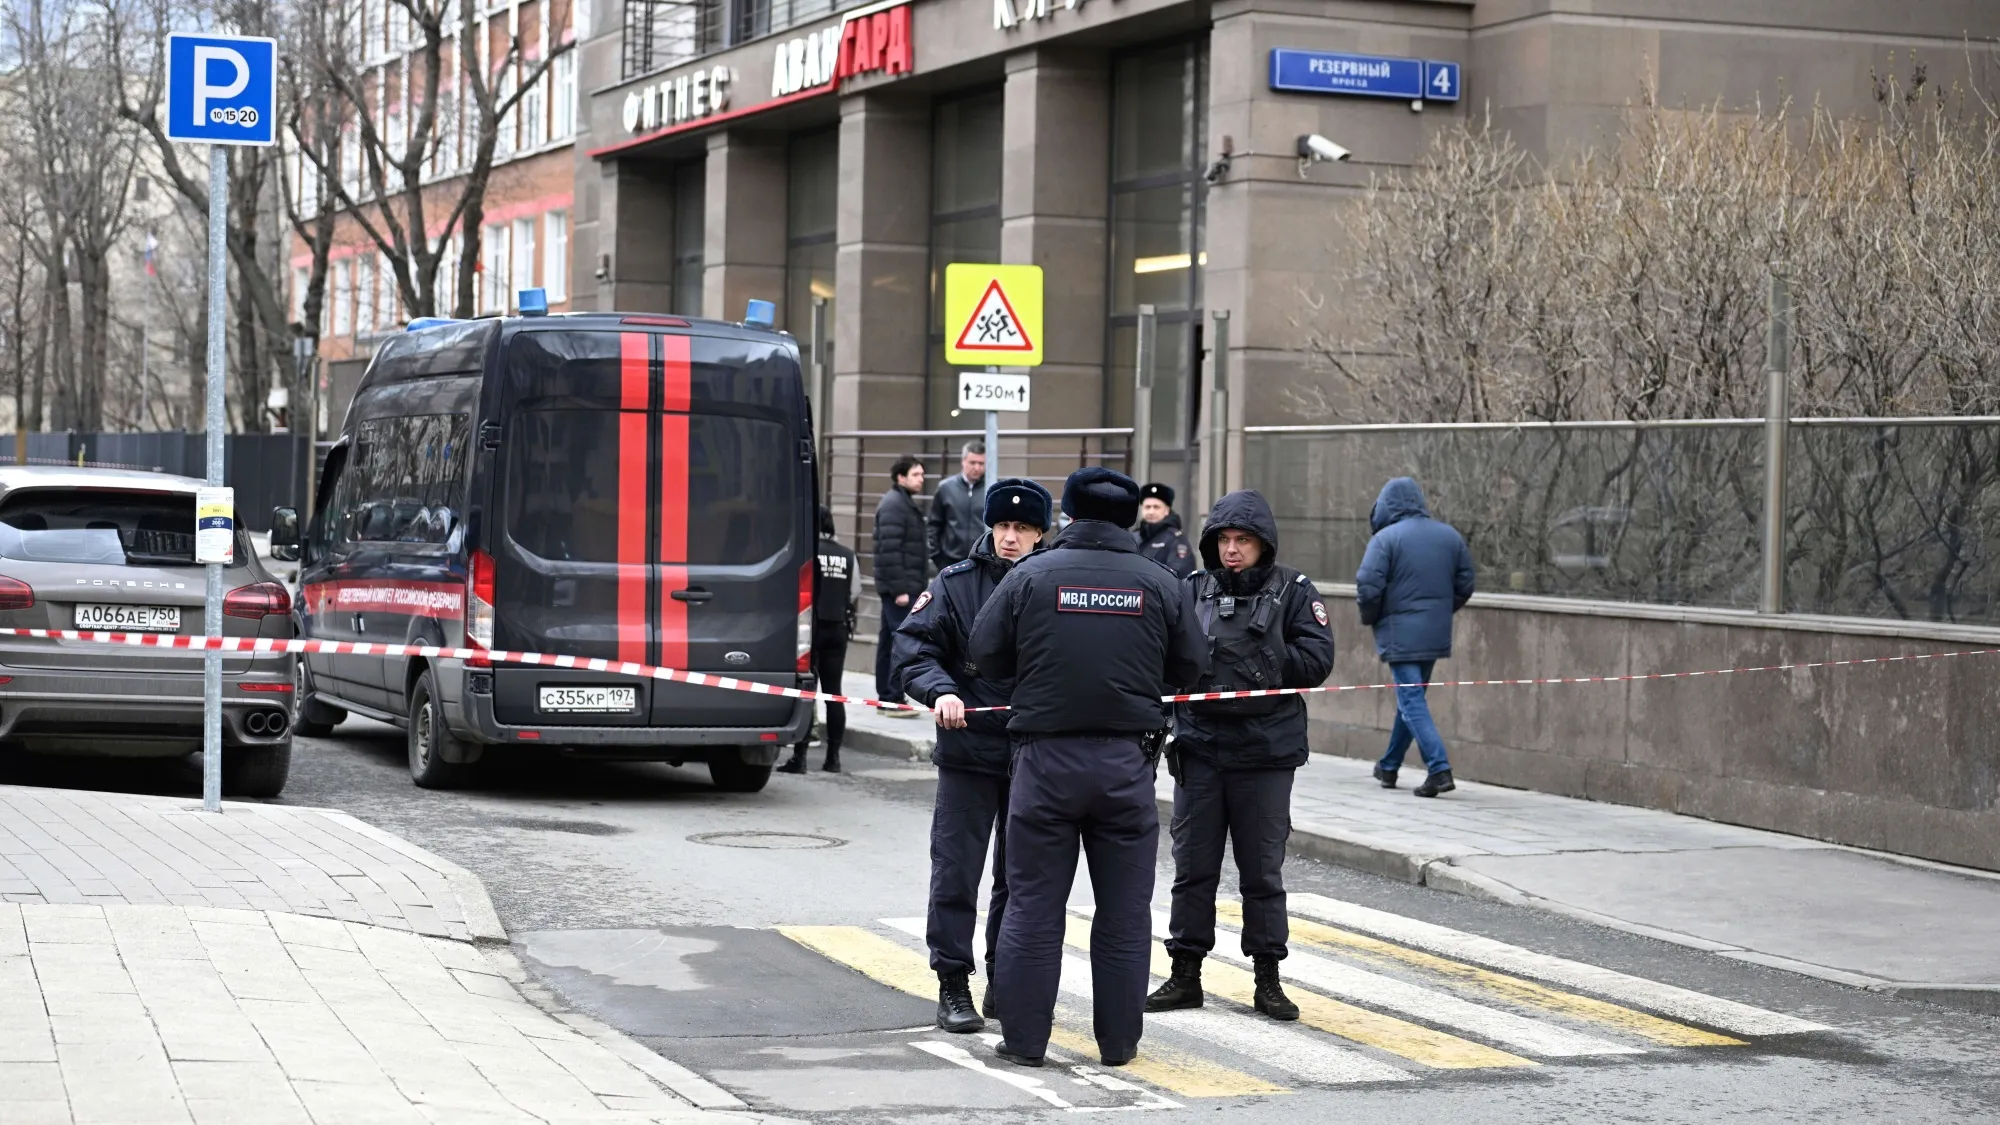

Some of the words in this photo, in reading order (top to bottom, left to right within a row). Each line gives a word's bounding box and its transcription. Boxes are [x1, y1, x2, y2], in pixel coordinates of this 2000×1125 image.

[771, 6, 912, 97] АВАНГАРД
[1309, 58, 1391, 78] РЕЗЕРВНЫЙ
[193, 45, 250, 126] P
[1432, 66, 1451, 94] 4
[623, 65, 729, 133] ФИТНЕС
[213, 111, 222, 119] 10
[225, 111, 236, 121] 15
[239, 110, 257, 122] 20
[76, 579, 185, 589] PORSCHE
[371, 587, 395, 604] КОМИТЕТ
[394, 586, 429, 606] РОССИЙСКОЙ
[428, 591, 461, 612] ФЕДЕРАЦИИ
[1060, 592, 1088, 607] МВД
[1090, 593, 1141, 608] РОССИИ
[151, 607, 176, 620] 750
[609, 689, 631, 701] 197
